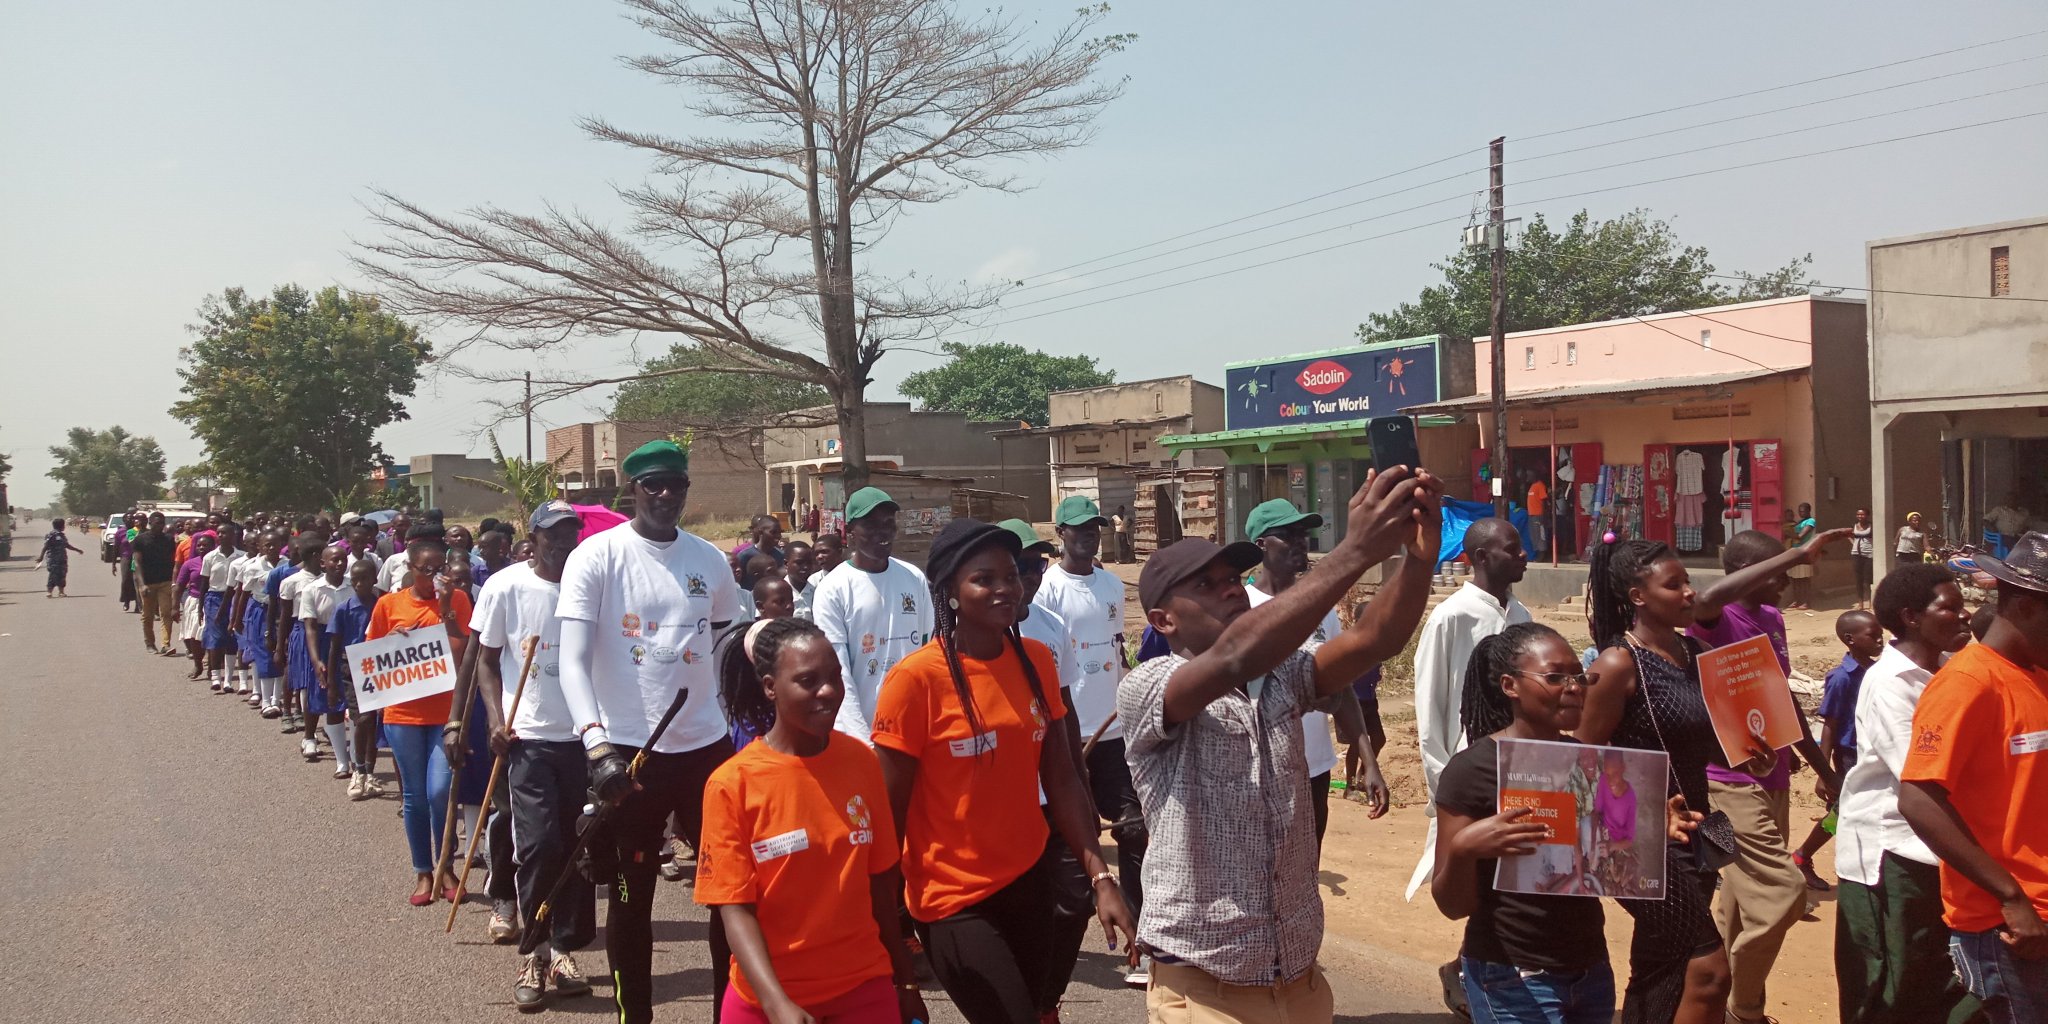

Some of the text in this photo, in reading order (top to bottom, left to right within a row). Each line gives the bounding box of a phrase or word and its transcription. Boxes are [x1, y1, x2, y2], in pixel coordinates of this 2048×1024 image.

[1303, 369, 1345, 387] Sadolin
[1280, 396, 1369, 417] Colour Your World
[622, 630, 641, 638] care
[361, 640, 443, 675] #MARCH
[362, 658, 448, 694] 4WOMEN
[1503, 795, 1542, 807] THERE IS NO
[1535, 808, 1559, 818] JUSTICE
[1646, 879, 1659, 888] care
